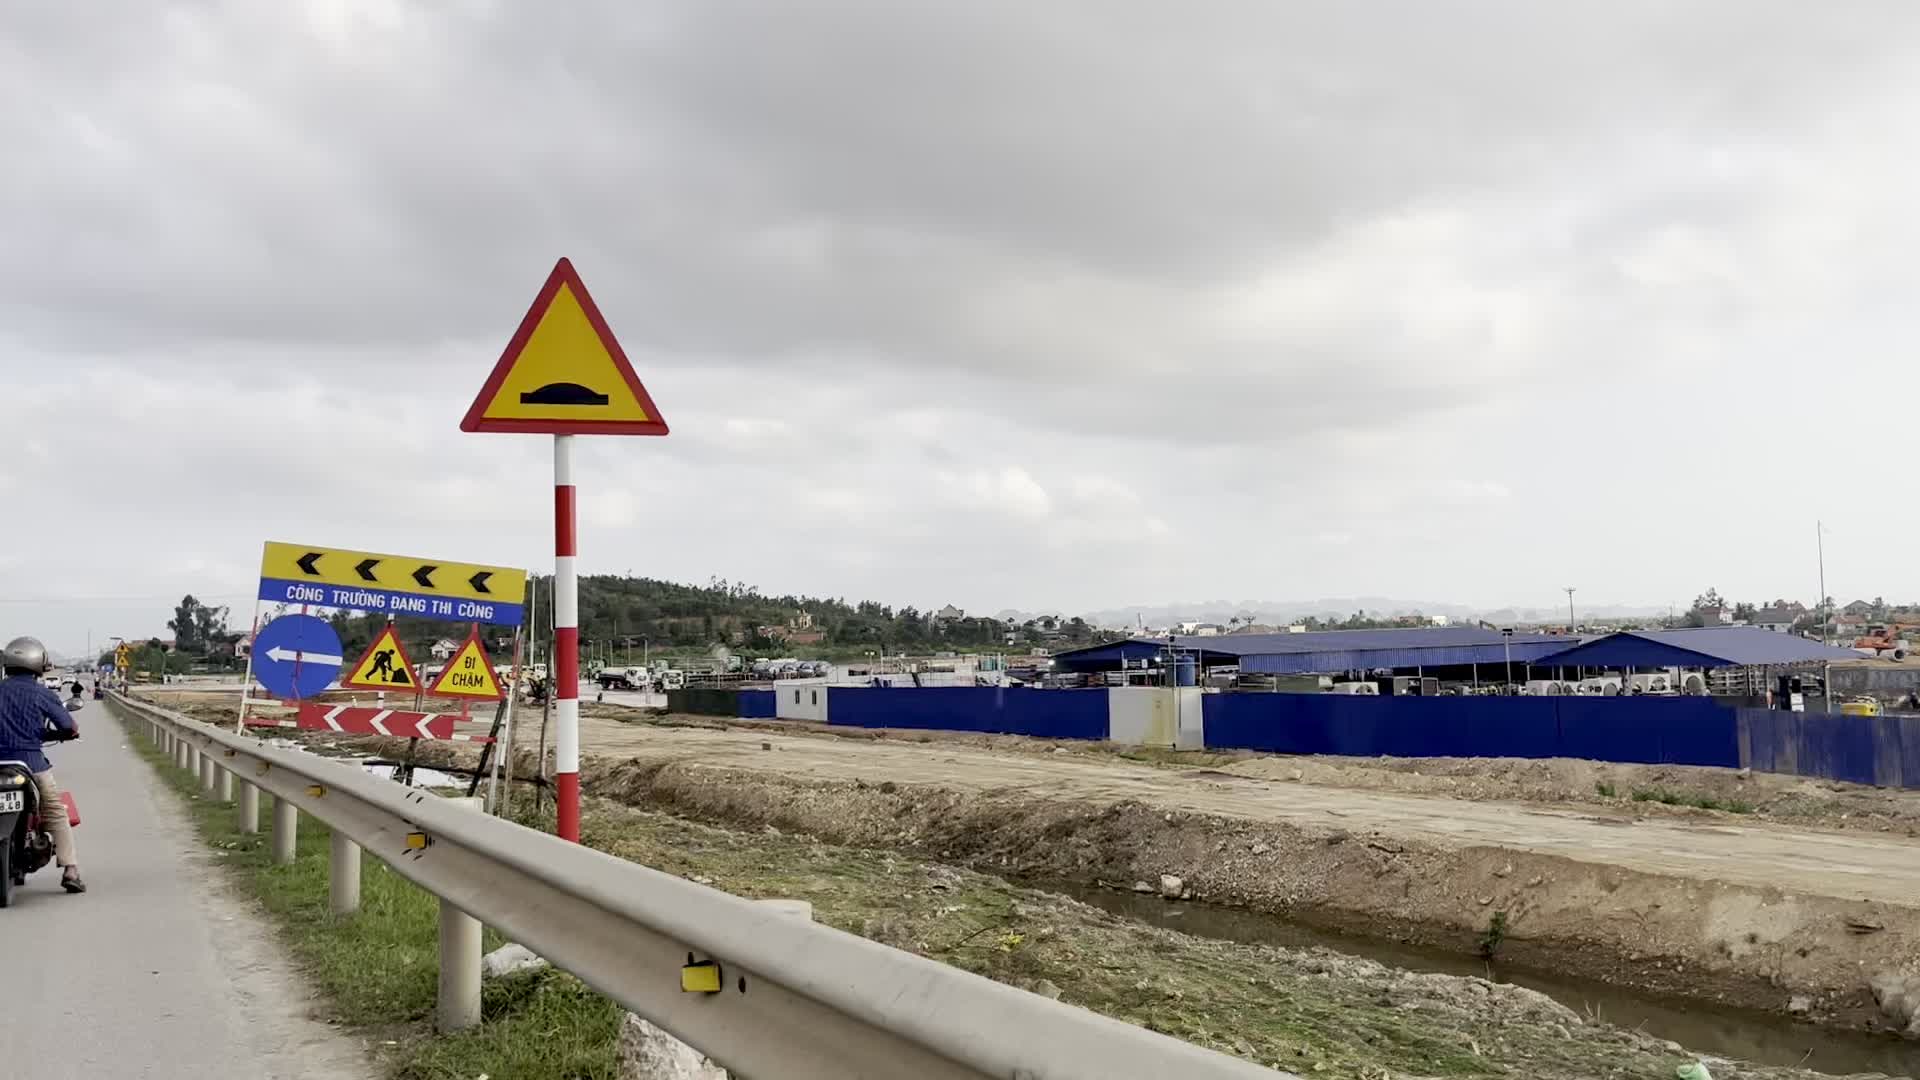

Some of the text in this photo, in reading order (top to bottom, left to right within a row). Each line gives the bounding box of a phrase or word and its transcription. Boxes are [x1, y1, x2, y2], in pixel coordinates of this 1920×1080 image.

[286, 584, 494, 619] CÔNG TRƯỜNG ĐANG THI CÔNG
[464, 656, 476, 669] ĐI
[452, 671, 484, 688] CHẬM
